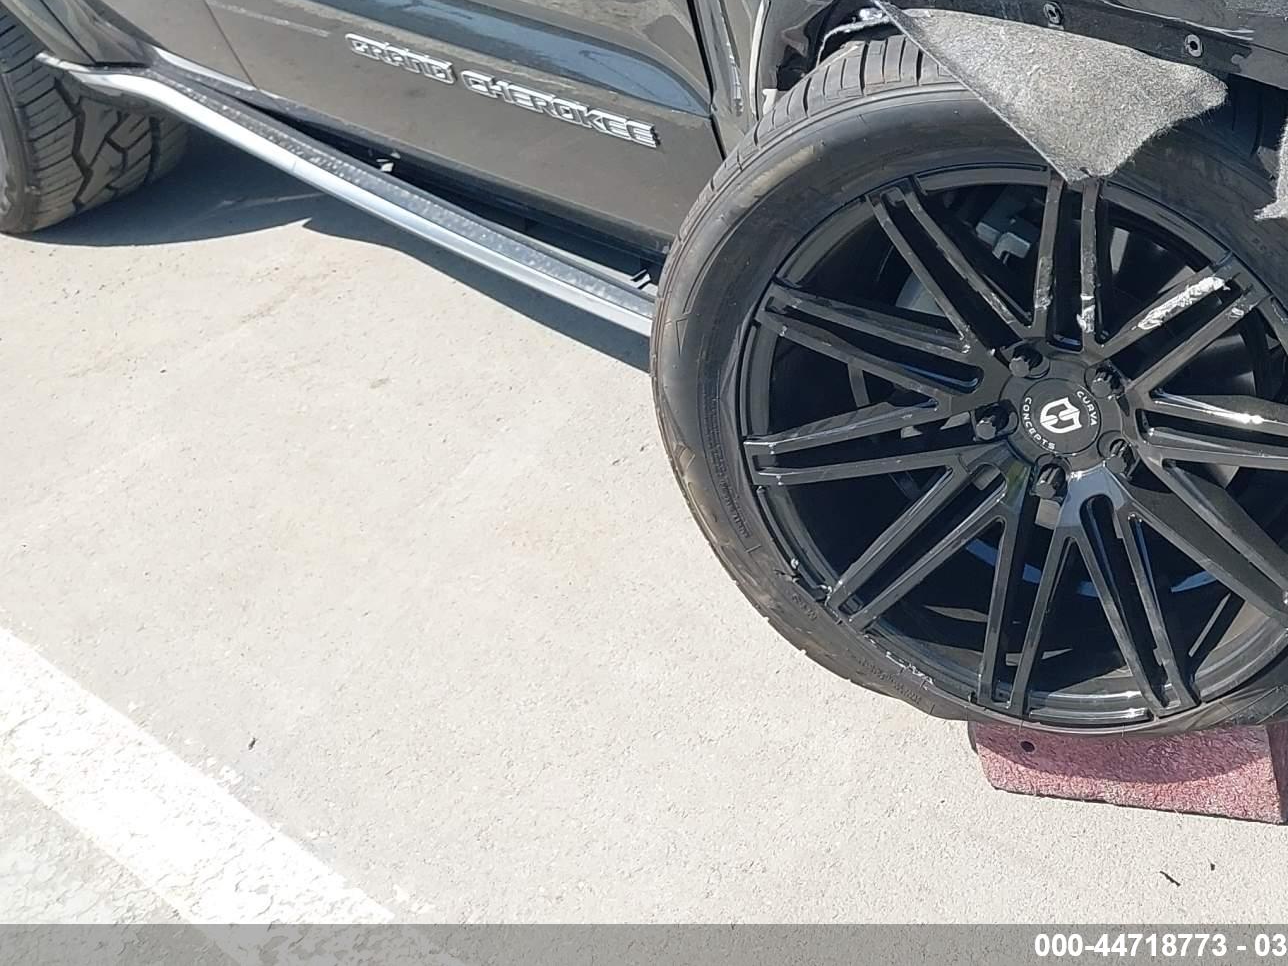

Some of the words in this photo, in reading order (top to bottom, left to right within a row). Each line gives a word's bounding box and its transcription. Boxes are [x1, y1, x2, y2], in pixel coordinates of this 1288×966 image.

[345, 33, 457, 85] GRAND
[460, 70, 661, 149] CHEROKEE
[1022, 397, 1056, 451] CONCEPTS
[1076, 390, 1098, 427] CURVA
